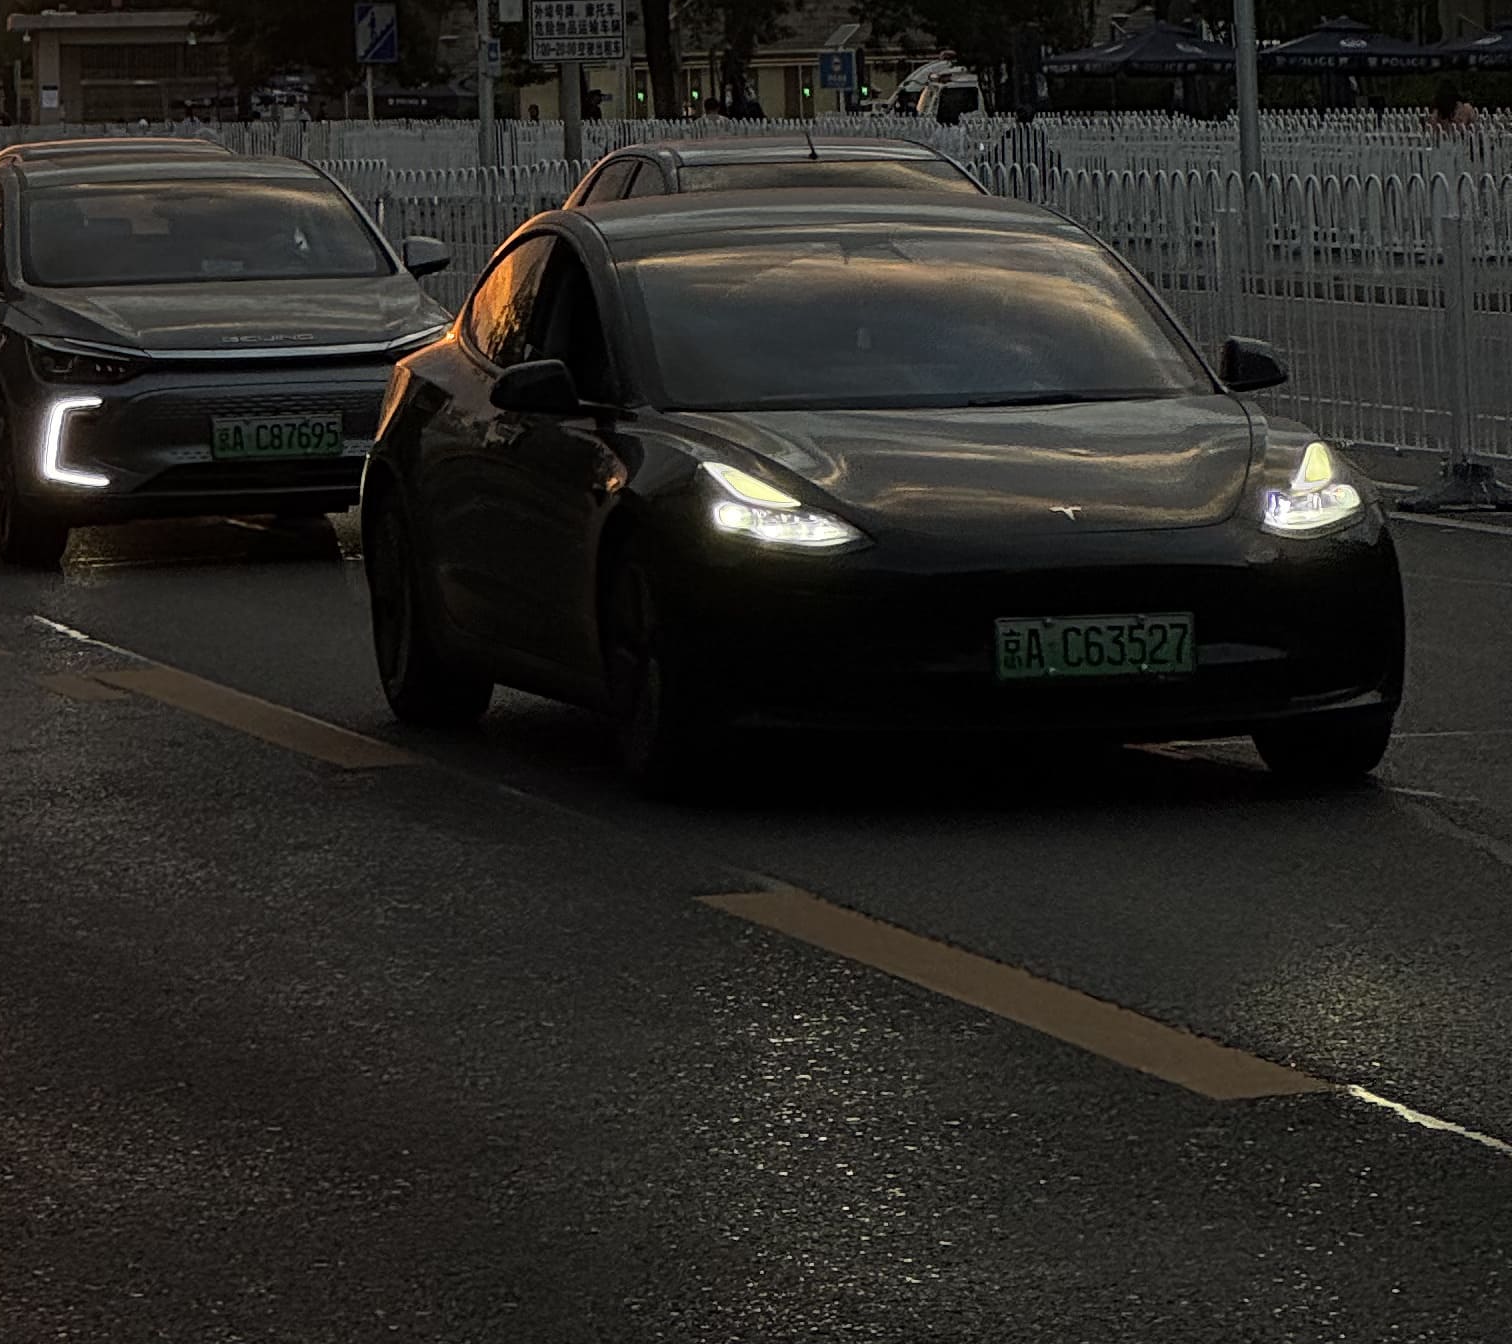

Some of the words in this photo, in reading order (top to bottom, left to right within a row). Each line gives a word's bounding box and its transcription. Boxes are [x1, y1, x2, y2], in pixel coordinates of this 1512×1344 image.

[222, 332, 314, 343] BEIJING
[255, 421, 339, 450] C87695
[1002, 628, 1045, 670] 京A
[1062, 623, 1189, 667] C63527
